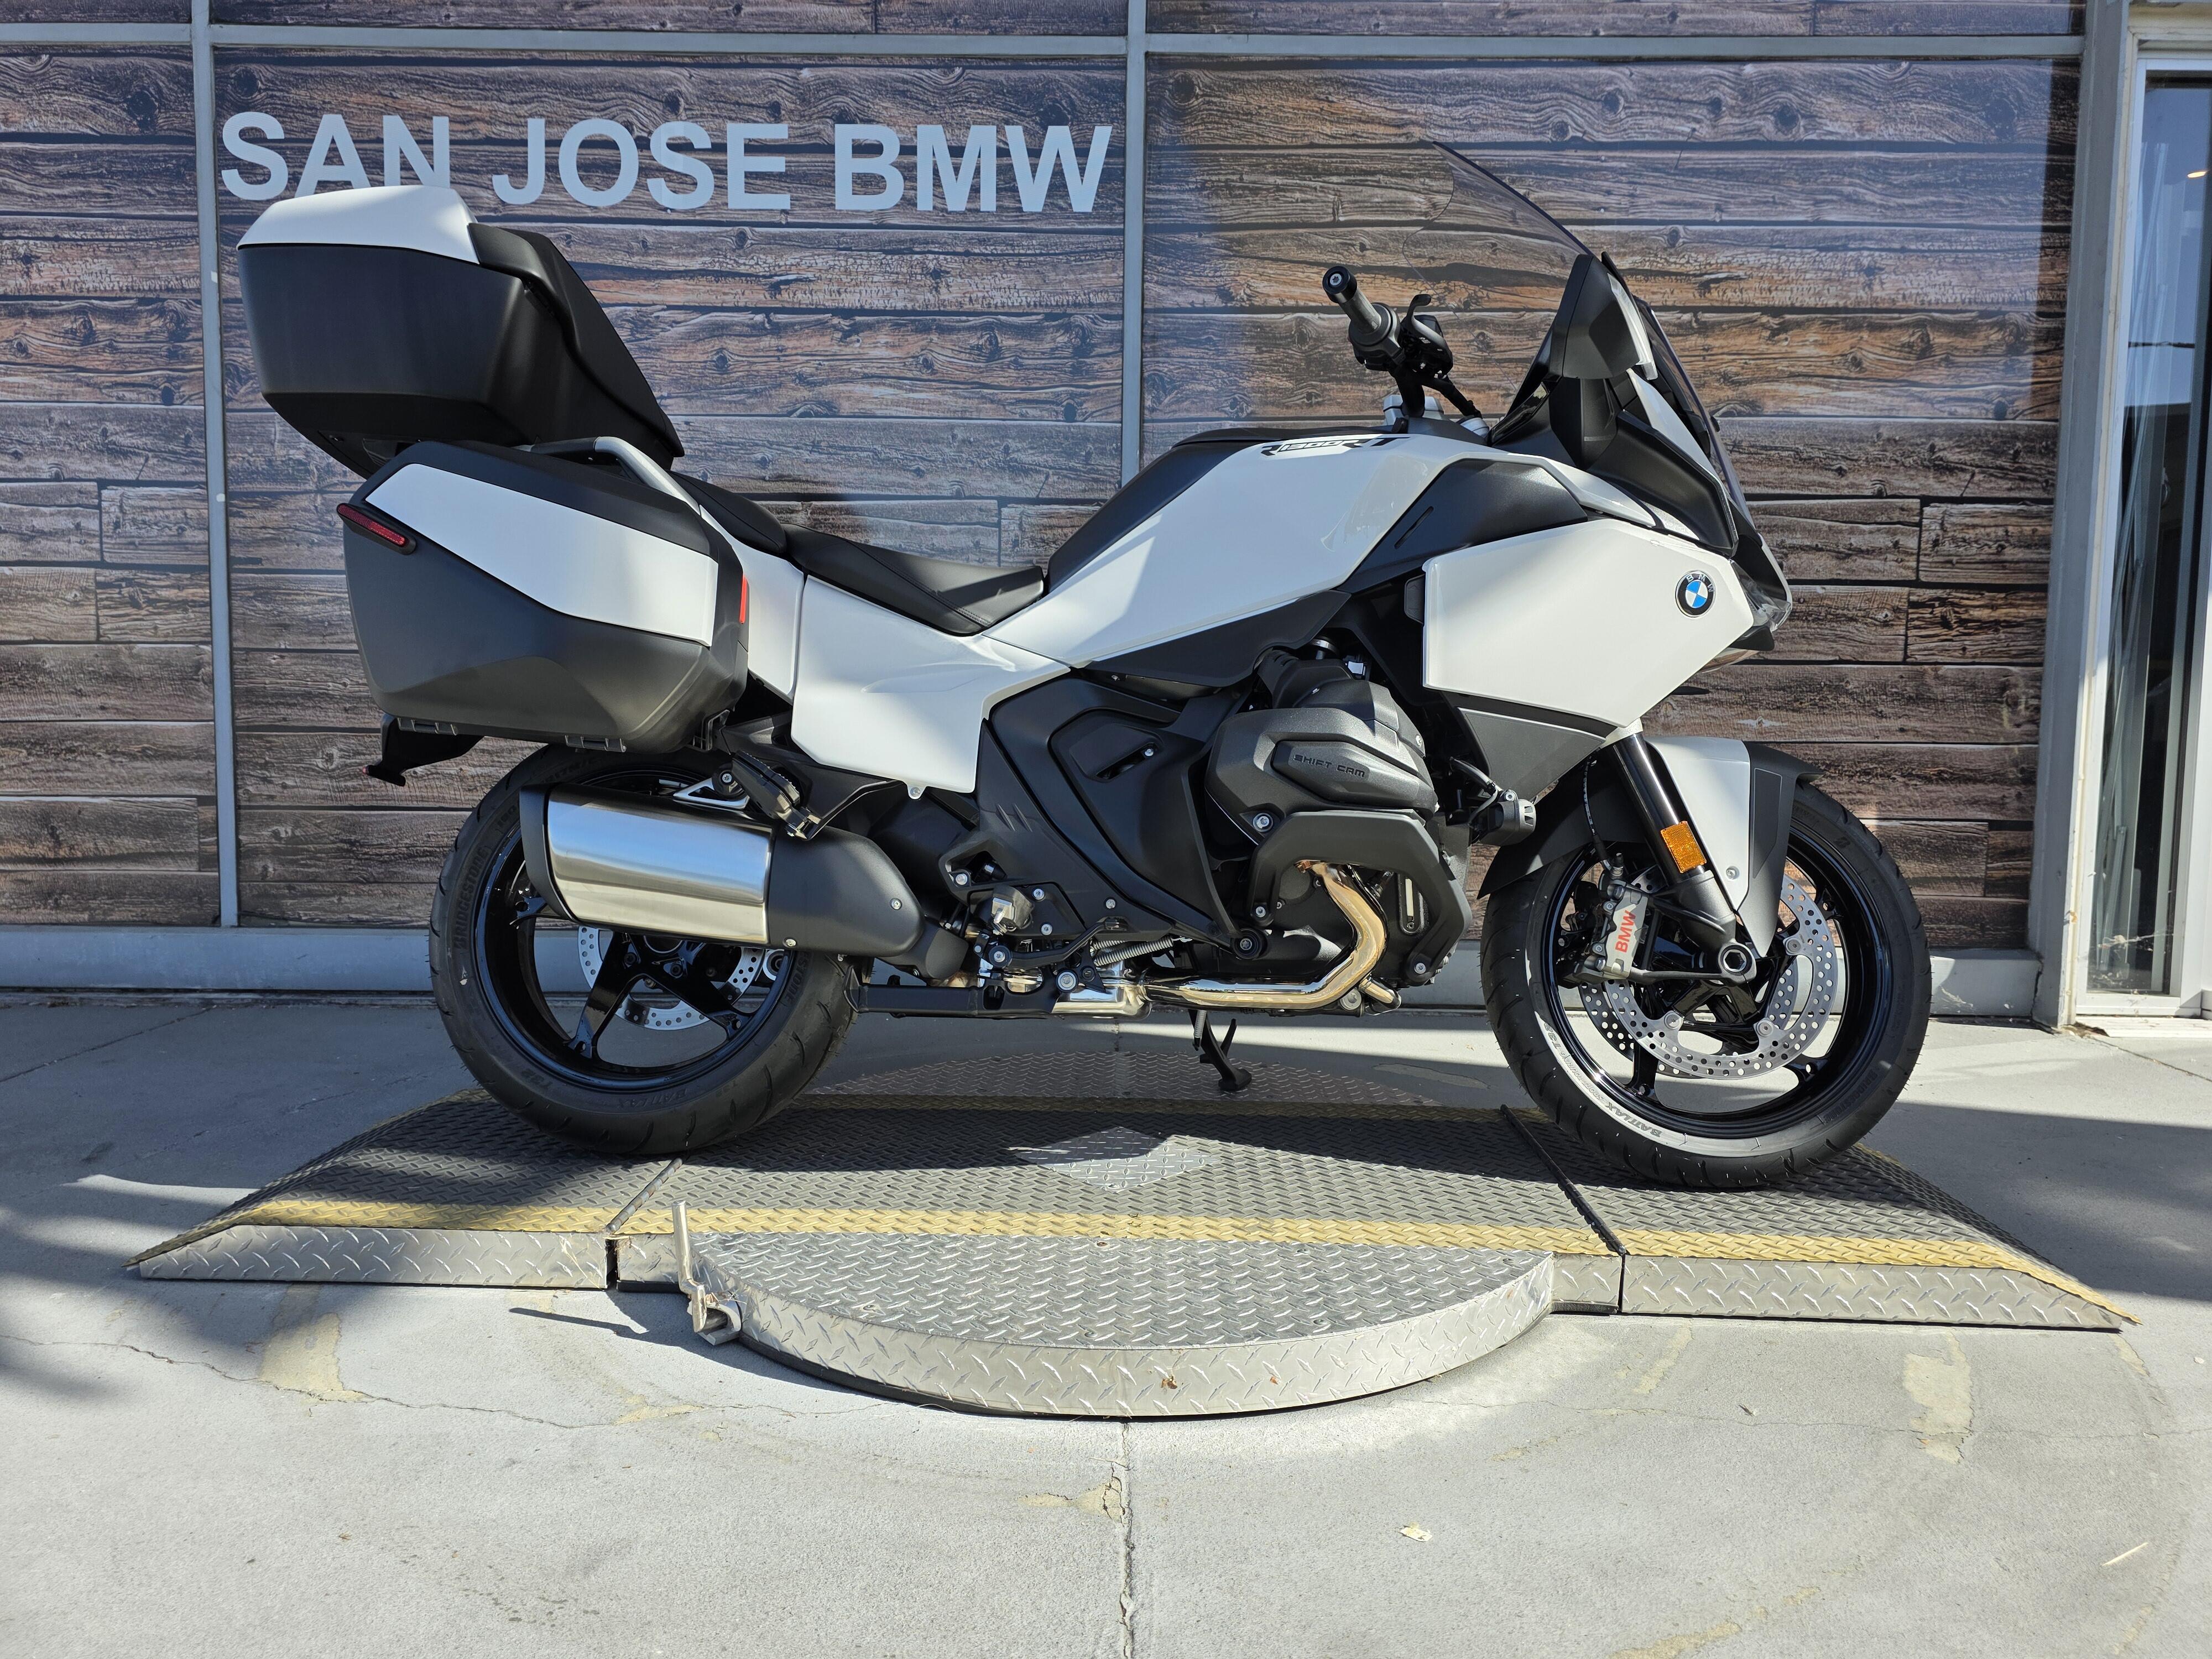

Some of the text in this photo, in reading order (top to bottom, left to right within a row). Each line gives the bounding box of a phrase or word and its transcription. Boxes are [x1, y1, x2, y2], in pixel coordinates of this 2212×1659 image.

[221, 111, 1113, 213] SAN JOSE BMW
[1685, 573, 1715, 593] BMW
[1293, 754, 1332, 769] SHIFT
[453, 846, 488, 950] BRIDGESTONE
[1615, 910, 1637, 953] BMW
[1605, 1102, 1662, 1138] BATTLAX
